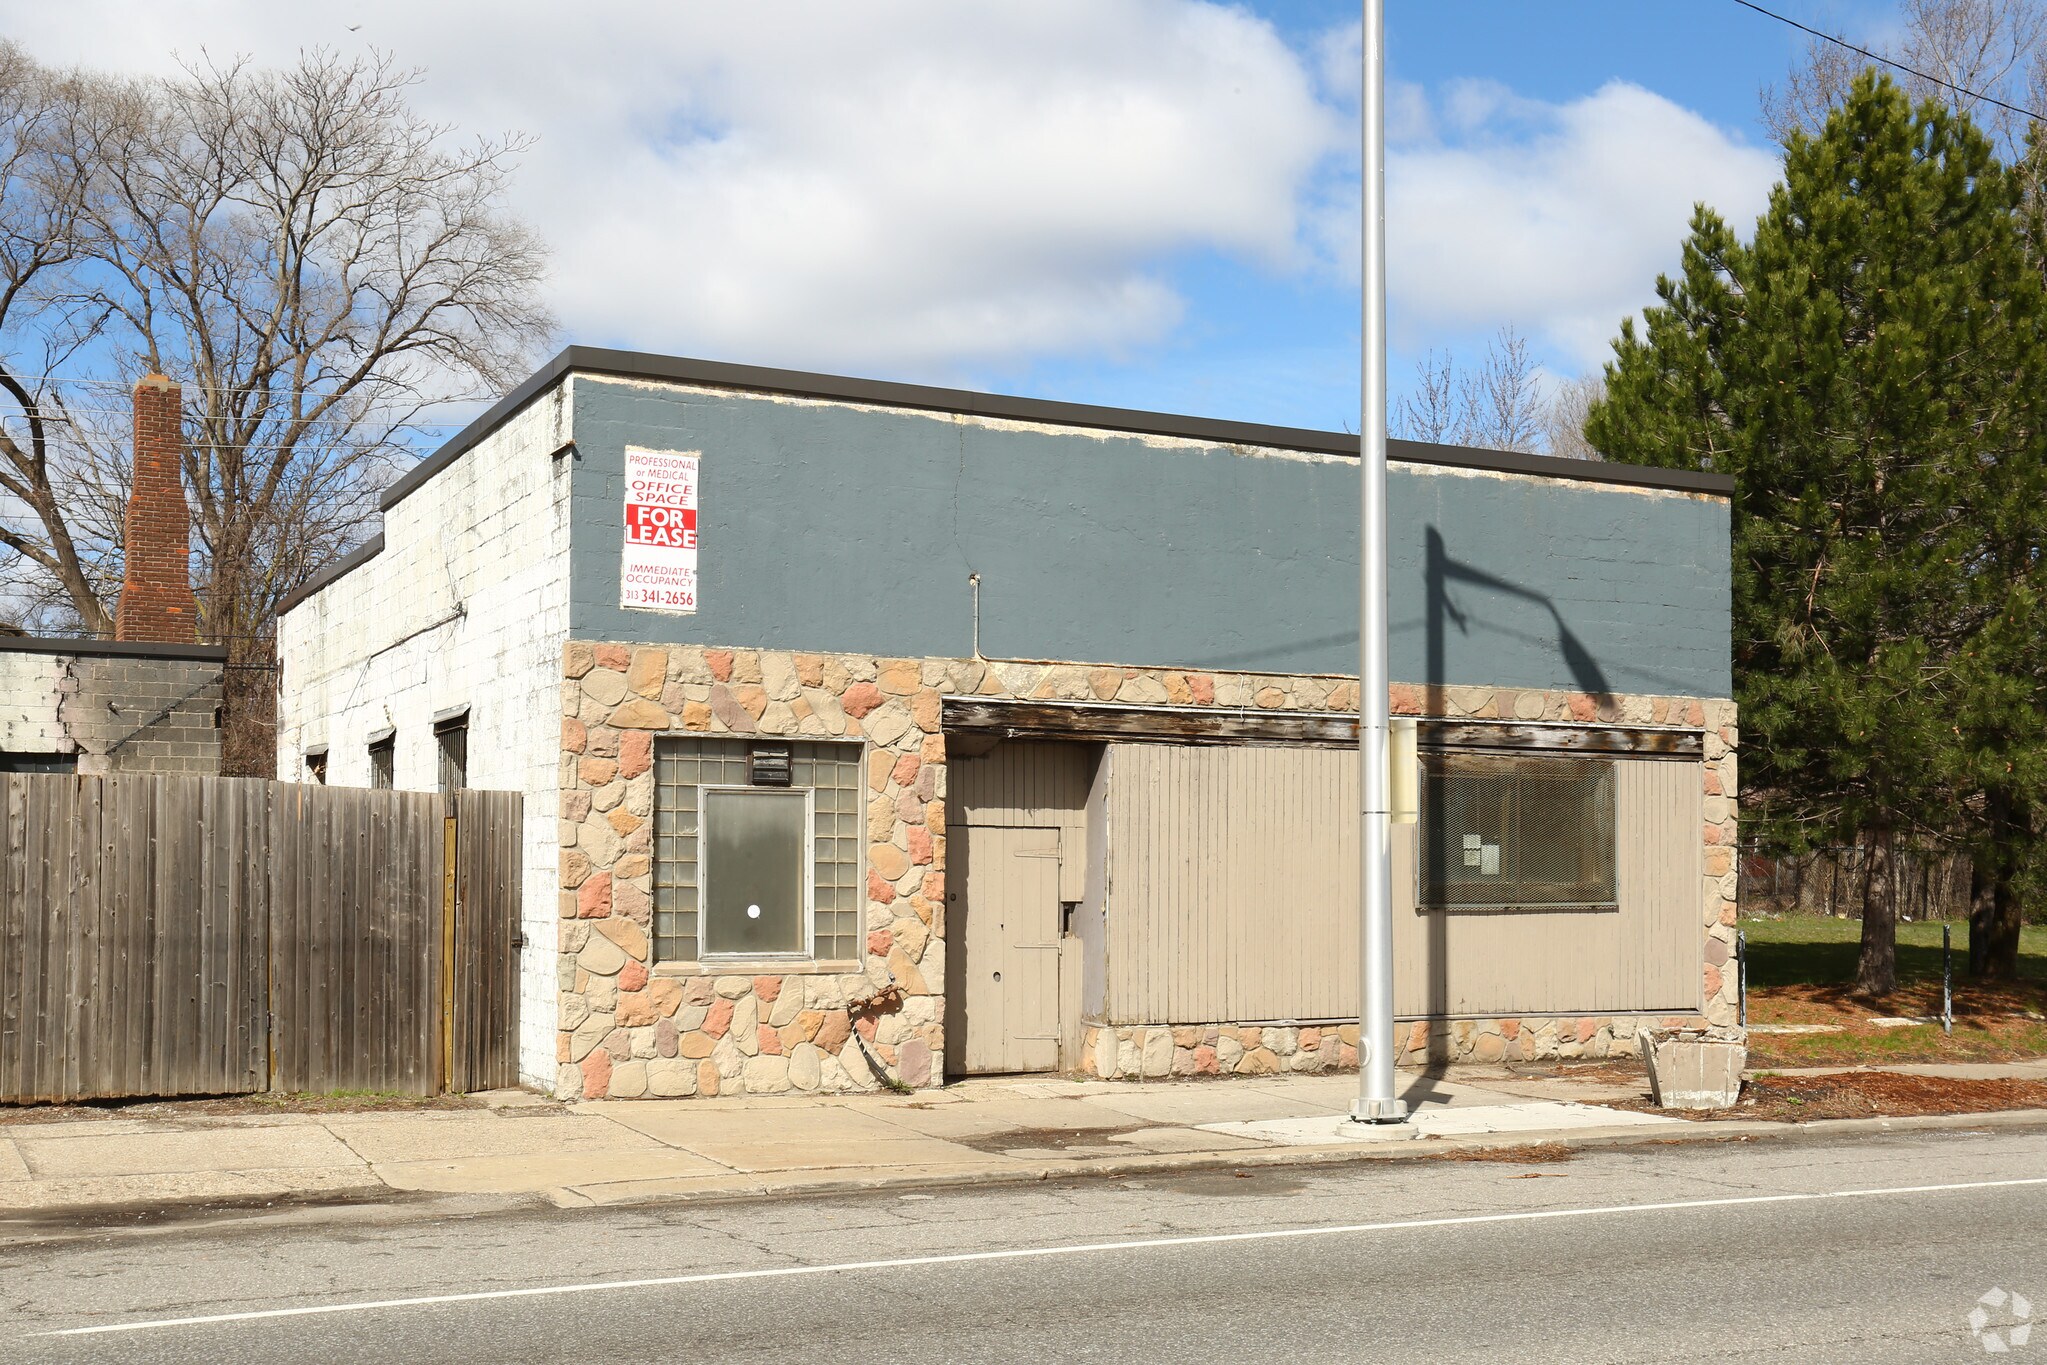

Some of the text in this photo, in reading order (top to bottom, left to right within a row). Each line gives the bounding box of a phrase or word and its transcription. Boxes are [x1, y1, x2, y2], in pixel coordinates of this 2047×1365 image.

[629, 455, 697, 471] PROFESSIONAL
[648, 469, 689, 481] MEDICAL
[632, 480, 693, 495] OFFICE
[635, 492, 689, 506] SPACE
[637, 506, 685, 528] FOR
[626, 524, 696, 548] LEASE
[630, 564, 690, 577] IMMEDIATE
[626, 574, 693, 587] OCCUPANCY
[626, 588, 693, 606] 313 341-2656
